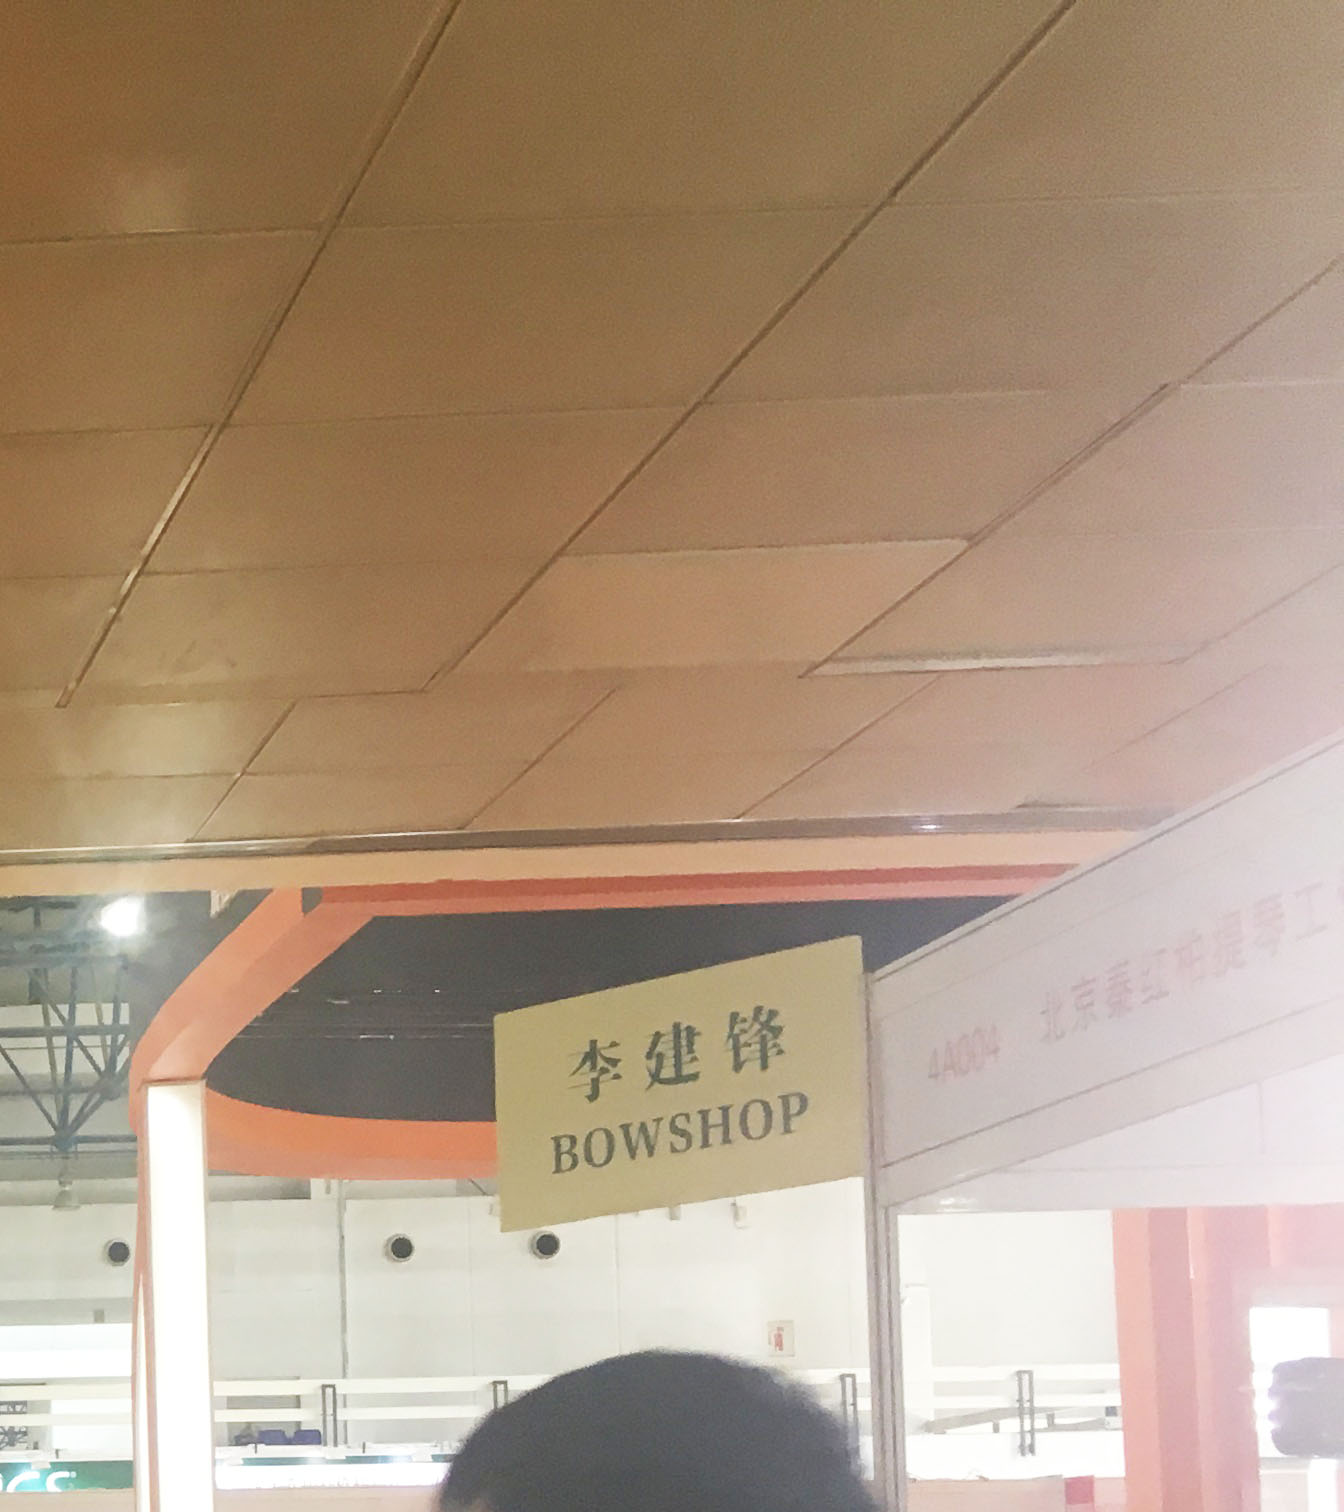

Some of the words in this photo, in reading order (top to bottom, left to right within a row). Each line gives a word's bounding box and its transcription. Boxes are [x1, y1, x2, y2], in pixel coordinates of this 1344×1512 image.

[568, 1004, 786, 1103] 李建锋
[550, 1090, 810, 1175] BOWSHOP
